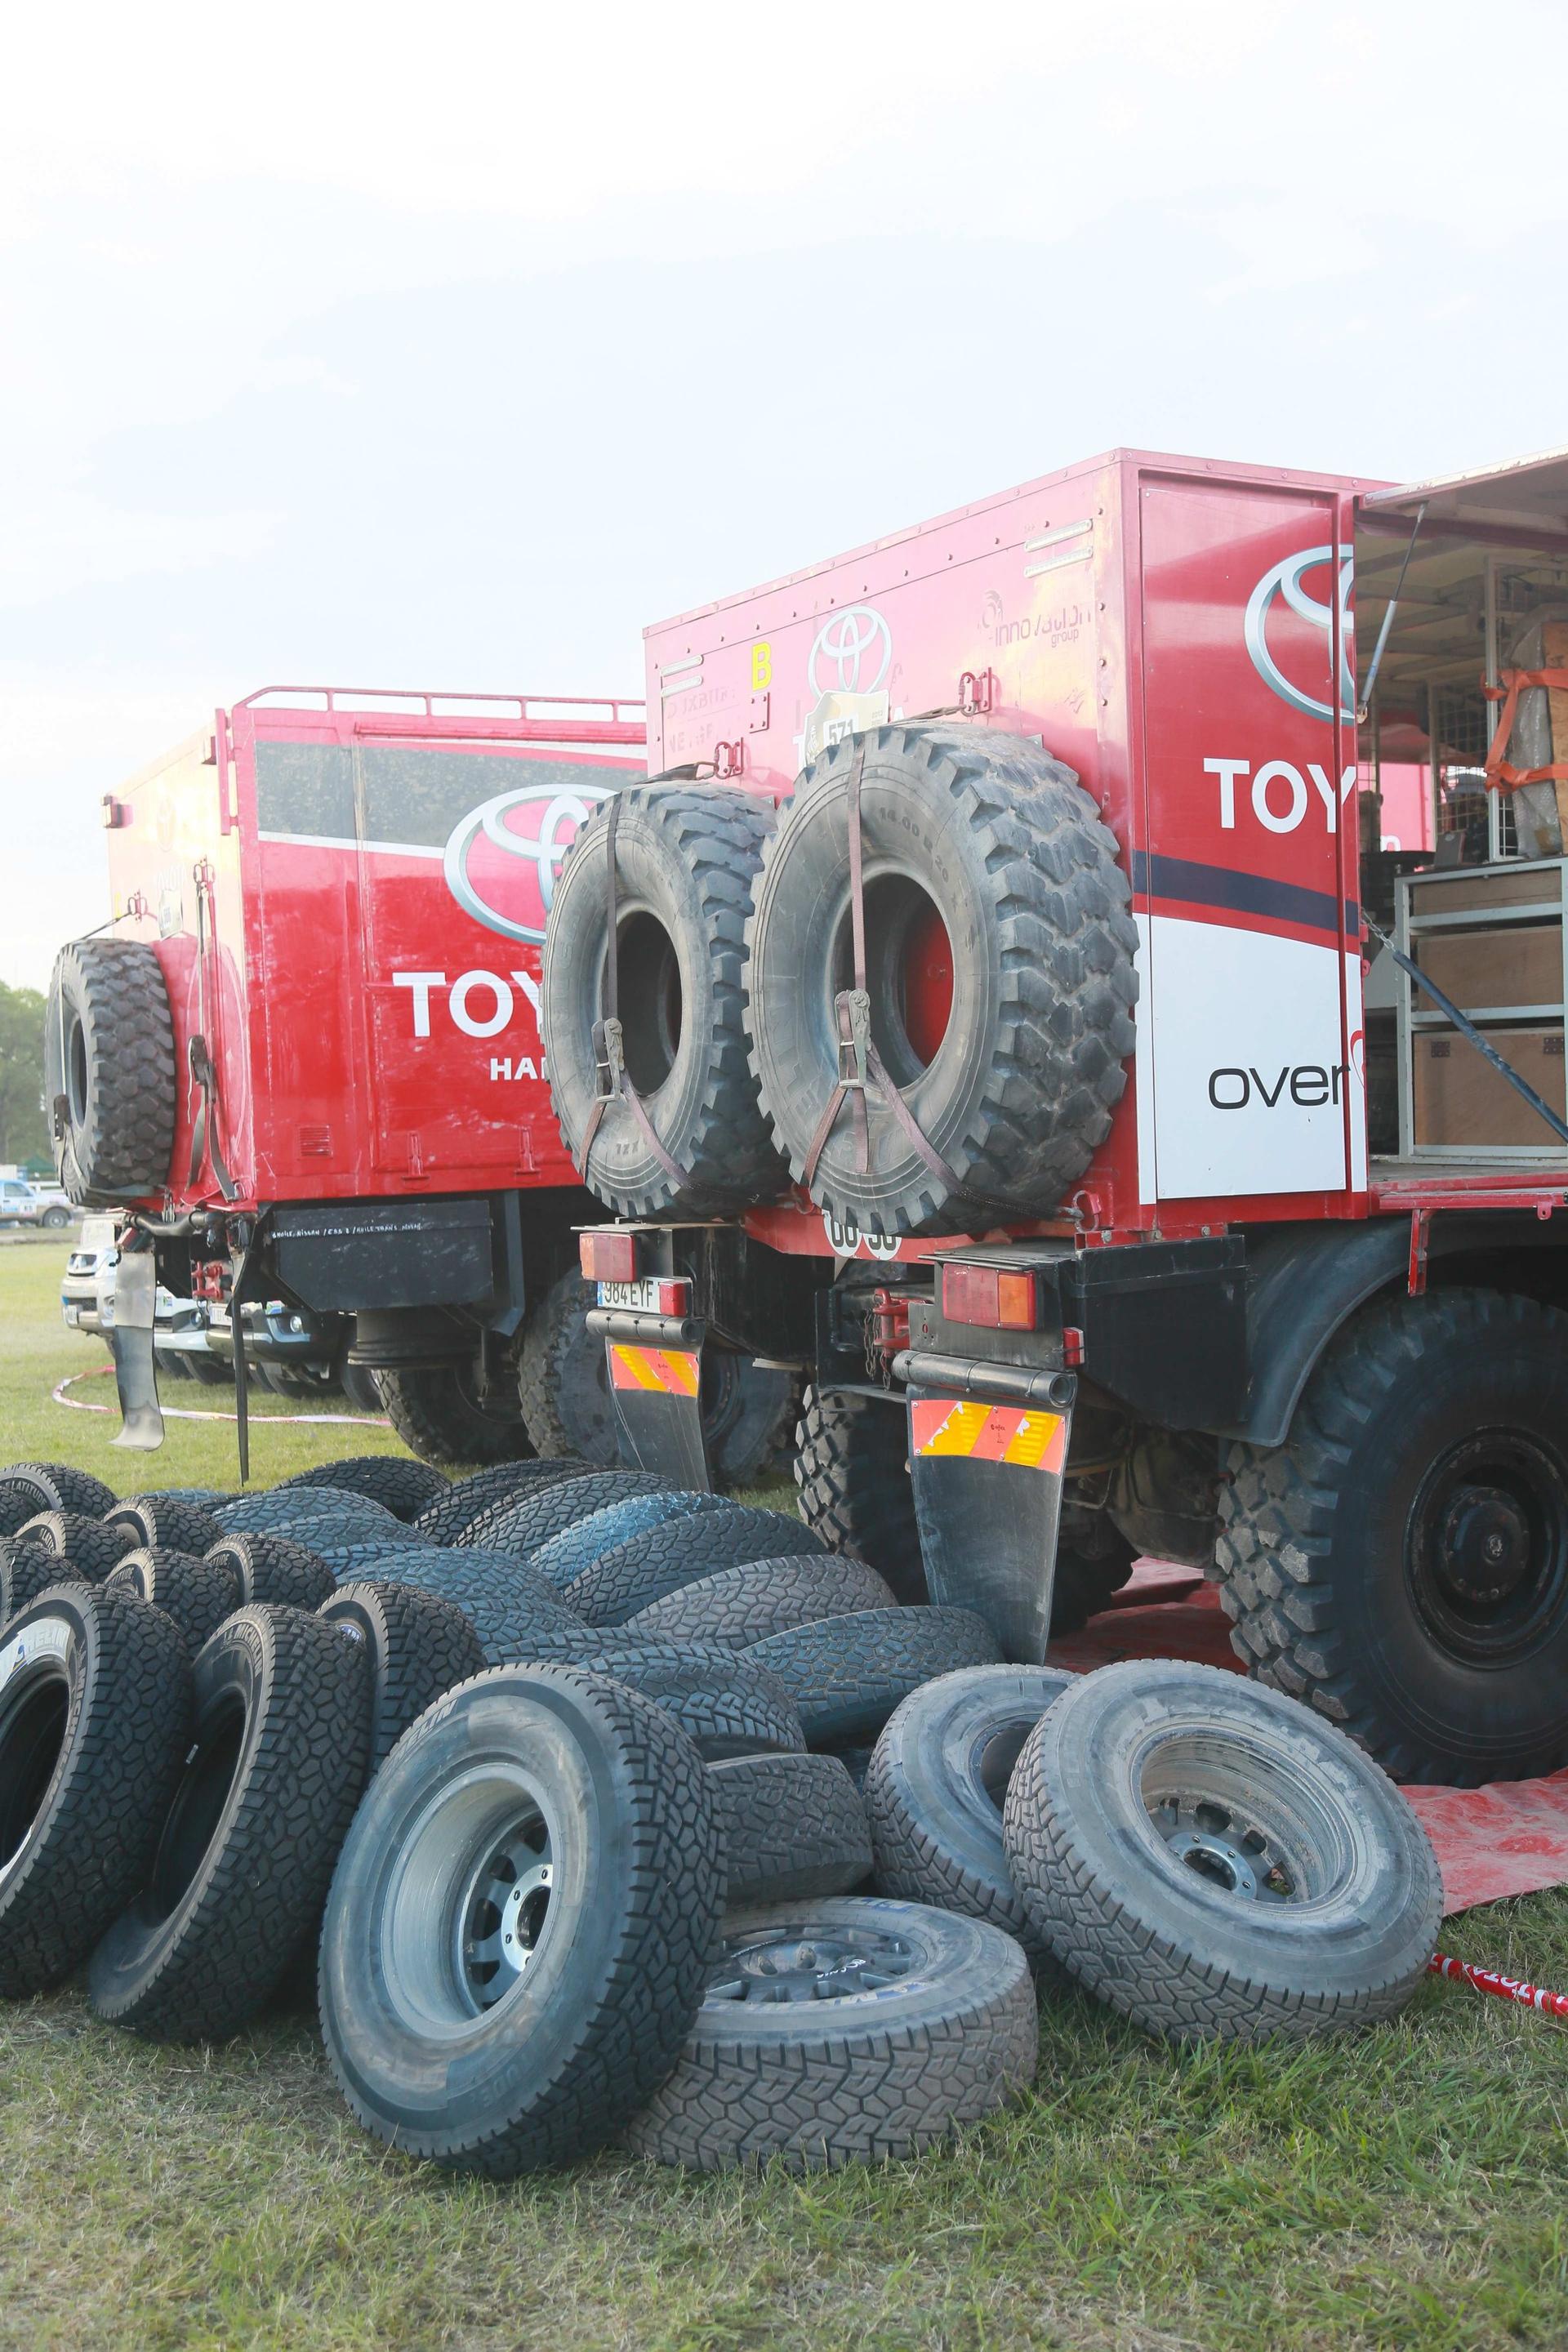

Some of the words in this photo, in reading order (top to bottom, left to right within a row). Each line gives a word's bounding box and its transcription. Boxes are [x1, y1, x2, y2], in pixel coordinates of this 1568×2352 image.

[1051, 628, 1079, 648] group
[751, 641, 773, 691] B
[1204, 758, 1356, 833] TOY
[490, 1057, 546, 1080] HA
[1209, 1065, 1351, 1110] over
[11, 1480, 47, 1509] LATITUDE
